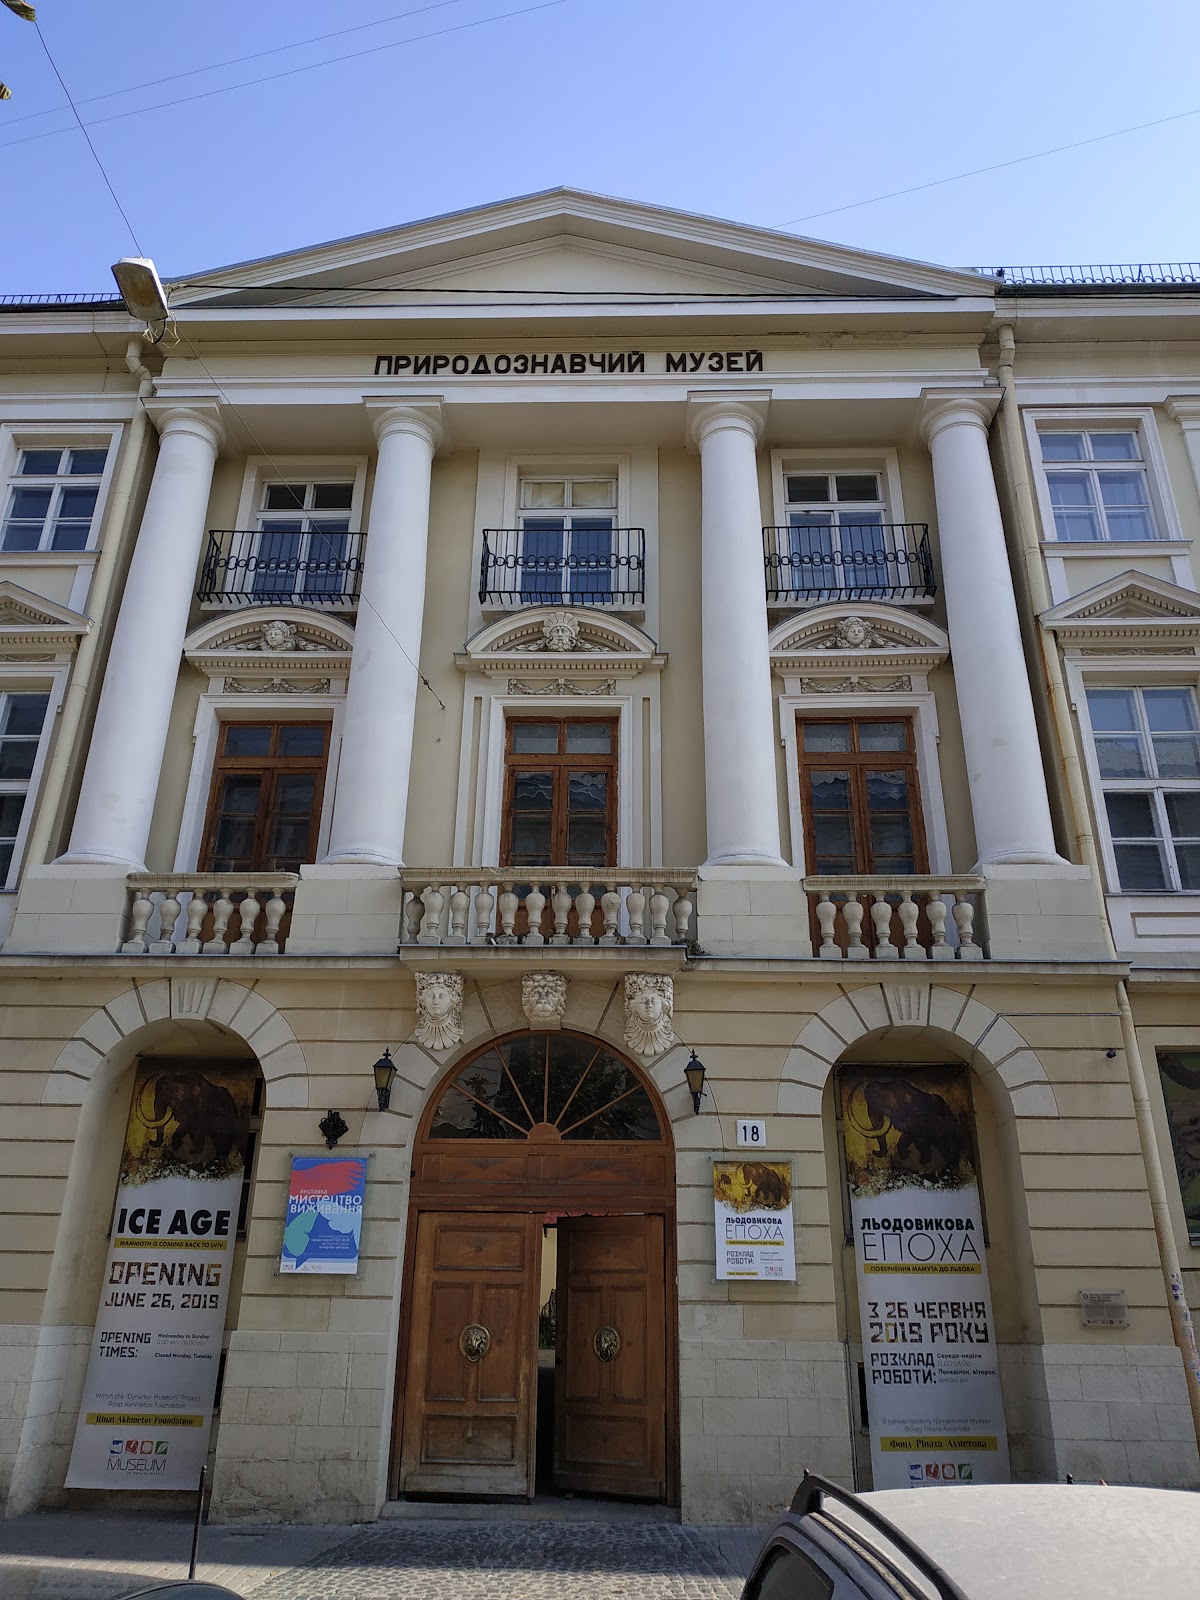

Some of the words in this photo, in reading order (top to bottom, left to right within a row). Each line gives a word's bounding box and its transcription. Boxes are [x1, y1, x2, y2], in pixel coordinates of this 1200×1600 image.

[374, 352, 645, 375] ПРИРОДОЗНАВЧИЙ
[665, 351, 763, 373] МУЗЕЙ
[743, 1125, 759, 1142] 18
[117, 1208, 162, 1234] ICE
[167, 1209, 230, 1236] AGE
[725, 1217, 782, 1225] ЛЬОДОВИКОВА
[861, 1218, 975, 1233] ЛЬОДОВИКОВА
[726, 1224, 784, 1240] ЕПОХА
[862, 1232, 980, 1262] ЕПОХА
[109, 1261, 222, 1287] OPENING
[104, 1292, 146, 1308] JUNE
[151, 1293, 175, 1311] 26,
[181, 1294, 220, 1309] 2019
[885, 1302, 909, 1319] 26
[914, 1302, 987, 1319] ЧЕРВНЯ
[100, 1332, 152, 1344] OPENING
[930, 1322, 989, 1343] РОКУ
[99, 1346, 139, 1358] TIMES:
[871, 1353, 935, 1368] РОЗКЛАД
[872, 1369, 937, 1384] РОБОТИ:
[96, 1415, 115, 1424] Rinat
[154, 1416, 194, 1425] Foundation
[107, 1458, 166, 1472] MUSEUM
